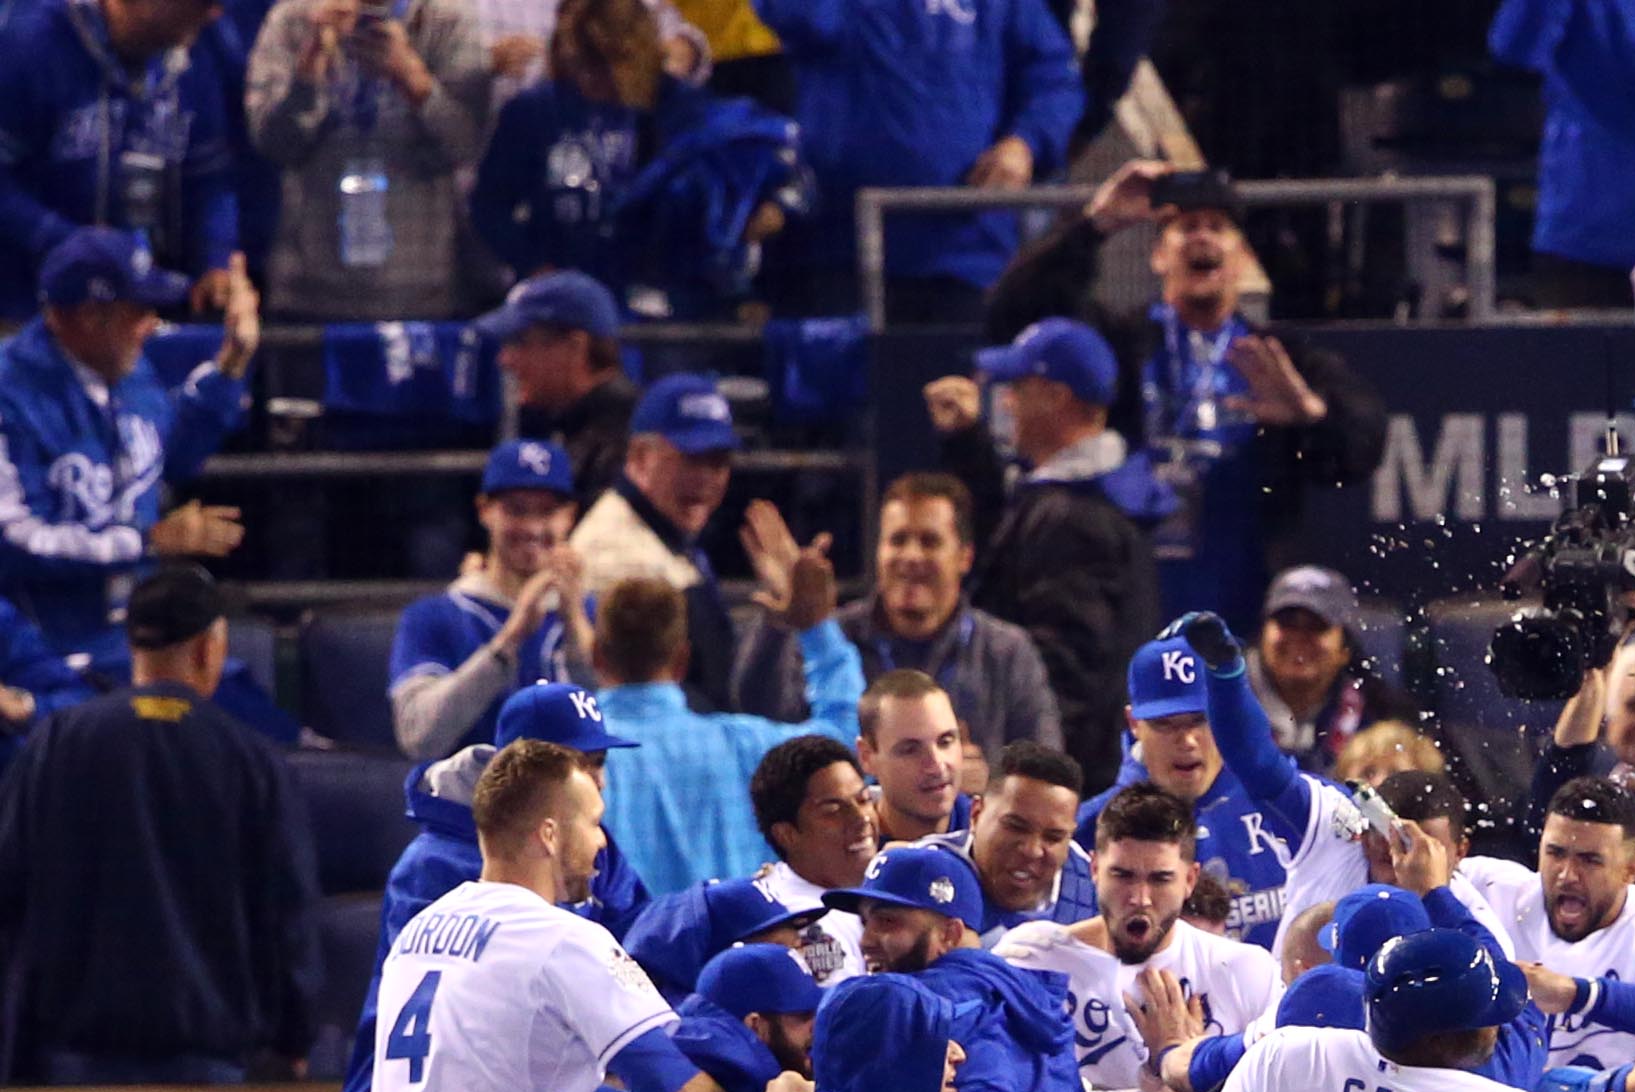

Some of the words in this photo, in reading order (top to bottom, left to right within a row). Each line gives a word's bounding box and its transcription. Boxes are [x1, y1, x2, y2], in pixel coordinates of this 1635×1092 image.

[1162, 651, 1196, 684] KC
[569, 691, 602, 722] KC
[386, 970, 442, 1084] 4
